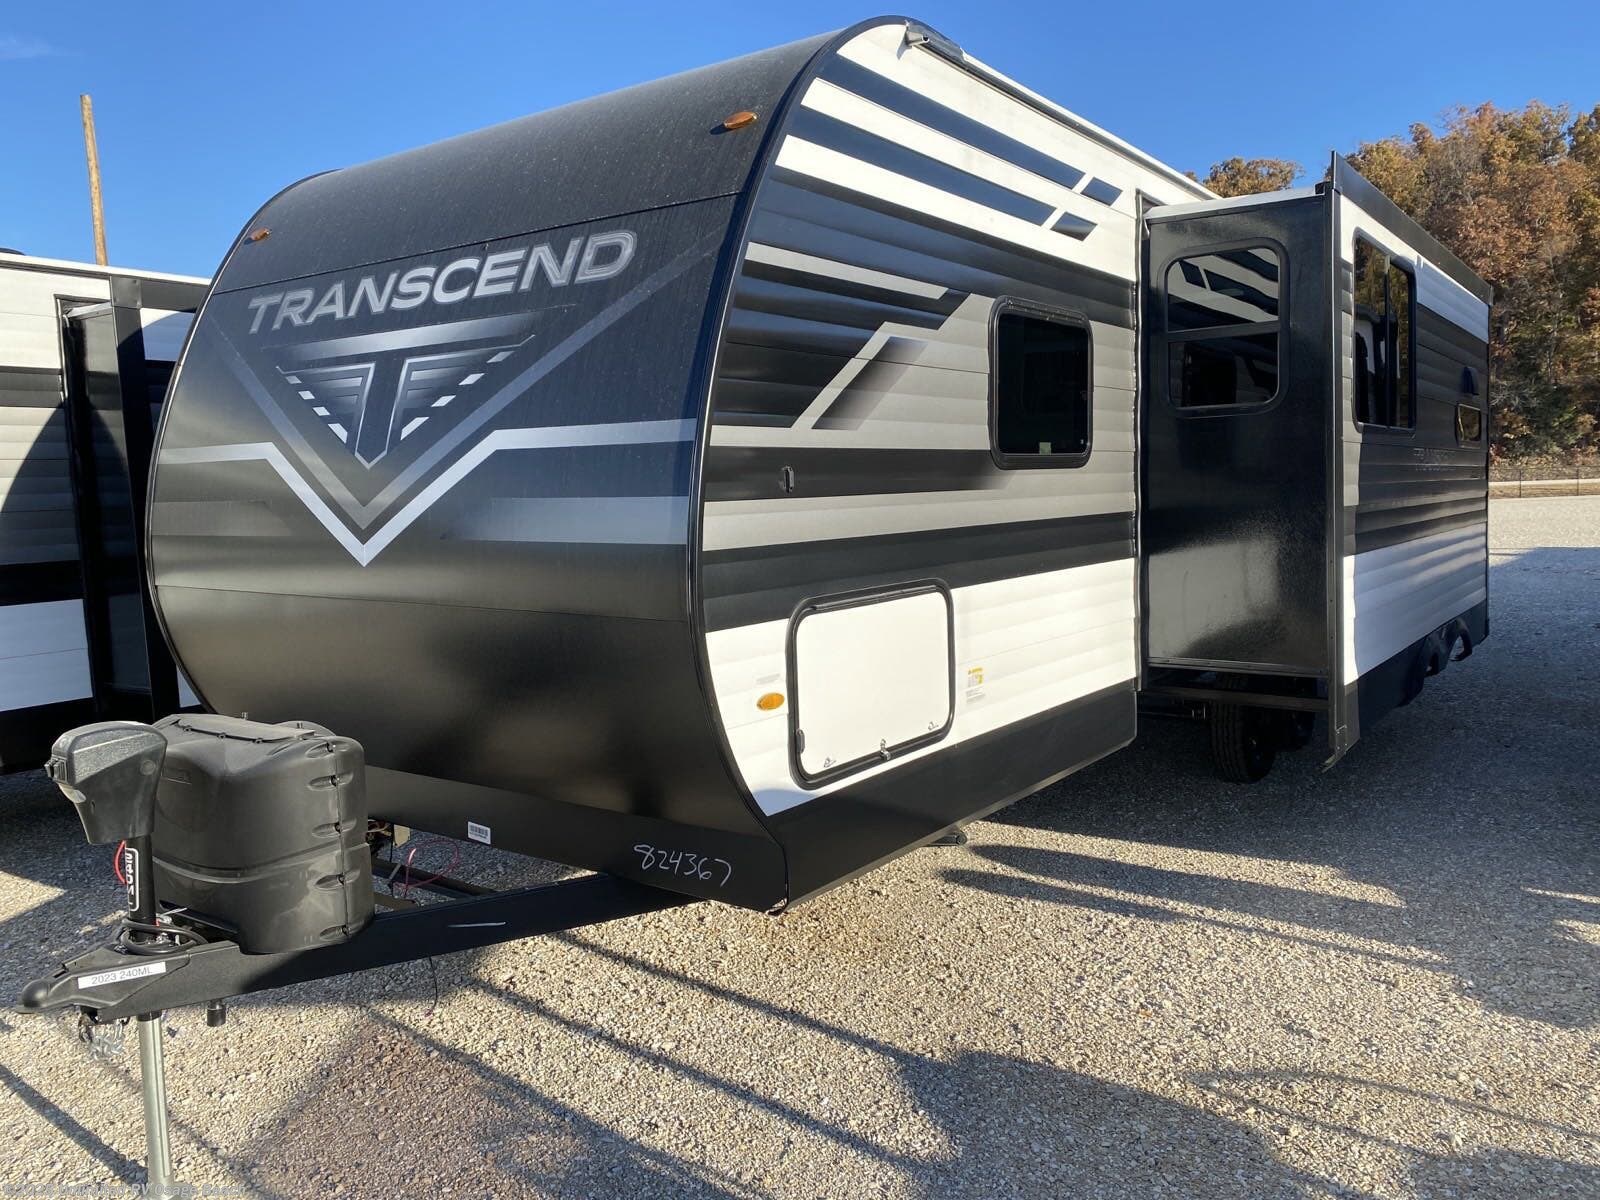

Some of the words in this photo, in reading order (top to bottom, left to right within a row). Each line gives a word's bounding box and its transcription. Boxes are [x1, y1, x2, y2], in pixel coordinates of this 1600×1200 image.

[248, 230, 637, 335] TRANSCEND
[633, 843, 732, 888] 824367
[91, 972, 117, 985] 2023
[120, 966, 153, 980] 240ML
